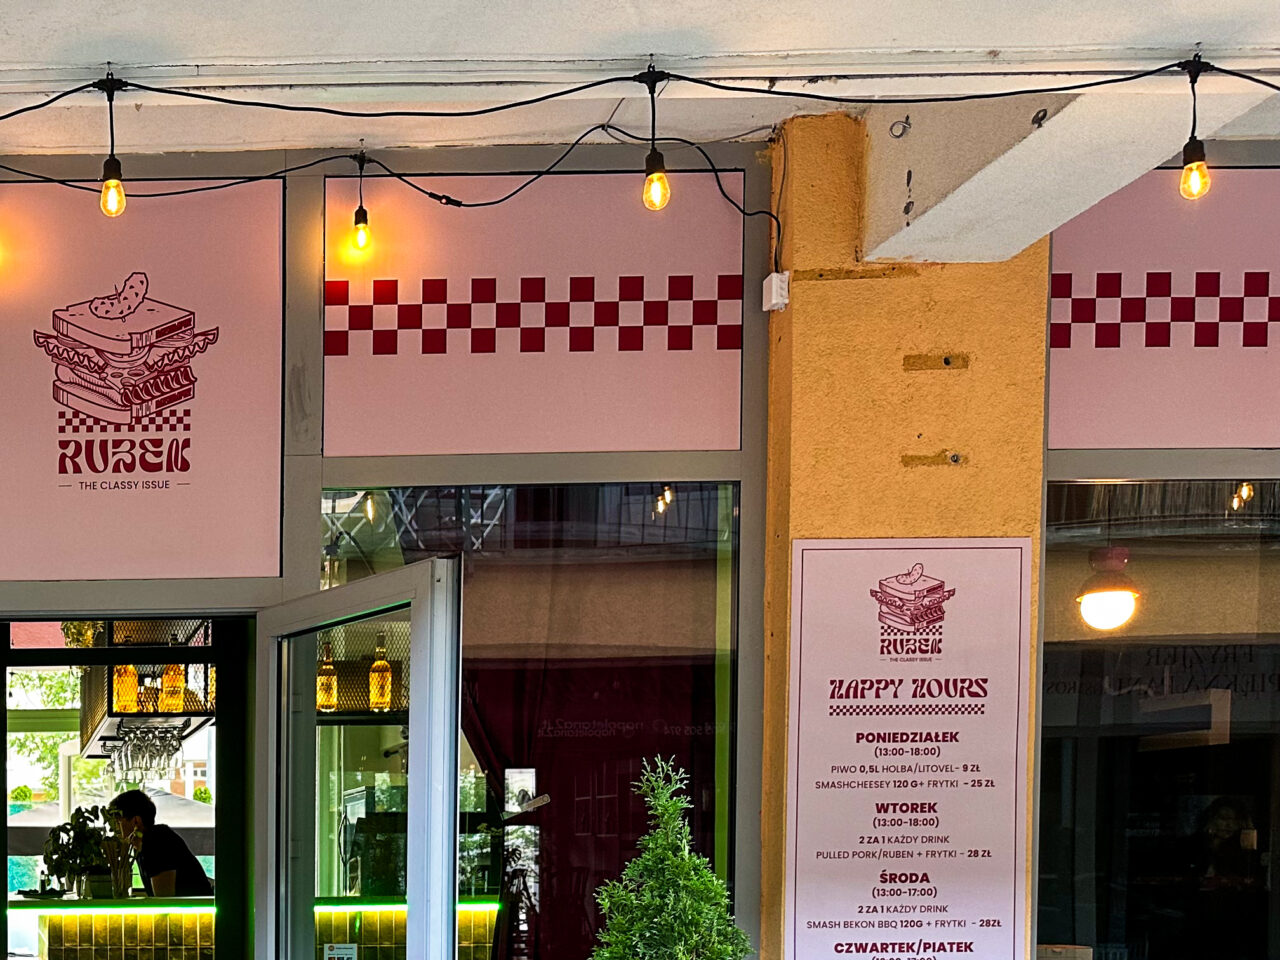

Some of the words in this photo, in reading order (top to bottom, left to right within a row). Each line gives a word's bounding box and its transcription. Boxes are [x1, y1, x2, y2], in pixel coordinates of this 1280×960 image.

[58, 437, 191, 475] RUBEN
[79, 481, 98, 490] THE
[100, 481, 139, 490] CLASSY
[141, 480, 170, 489] ISSUE
[880, 638, 942, 655] RUBEN
[856, 732, 959, 743] PONIEDZIAŁEK
[874, 746, 941, 758] (13:00-18:00)
[859, 765, 880, 774] 0,5L
[962, 764, 968, 772] 9
[815, 781, 891, 789] SMASHCHEESEY
[893, 780, 909, 788] 120
[875, 802, 937, 813] WTOREK
[873, 816, 940, 829] (13:00-18:00)
[859, 836, 865, 844] 2
[881, 836, 886, 844] 1
[816, 851, 849, 859] PULLED
[852, 849, 914, 860] PORK/RUBEN
[925, 850, 957, 858] FRYTKI
[879, 869, 930, 883] ŚRODA
[872, 887, 938, 898] (13:00-17:00)
[886, 905, 917, 913] KAŻDY
[919, 905, 948, 913] DRINK
[878, 921, 898, 929] BBQ
